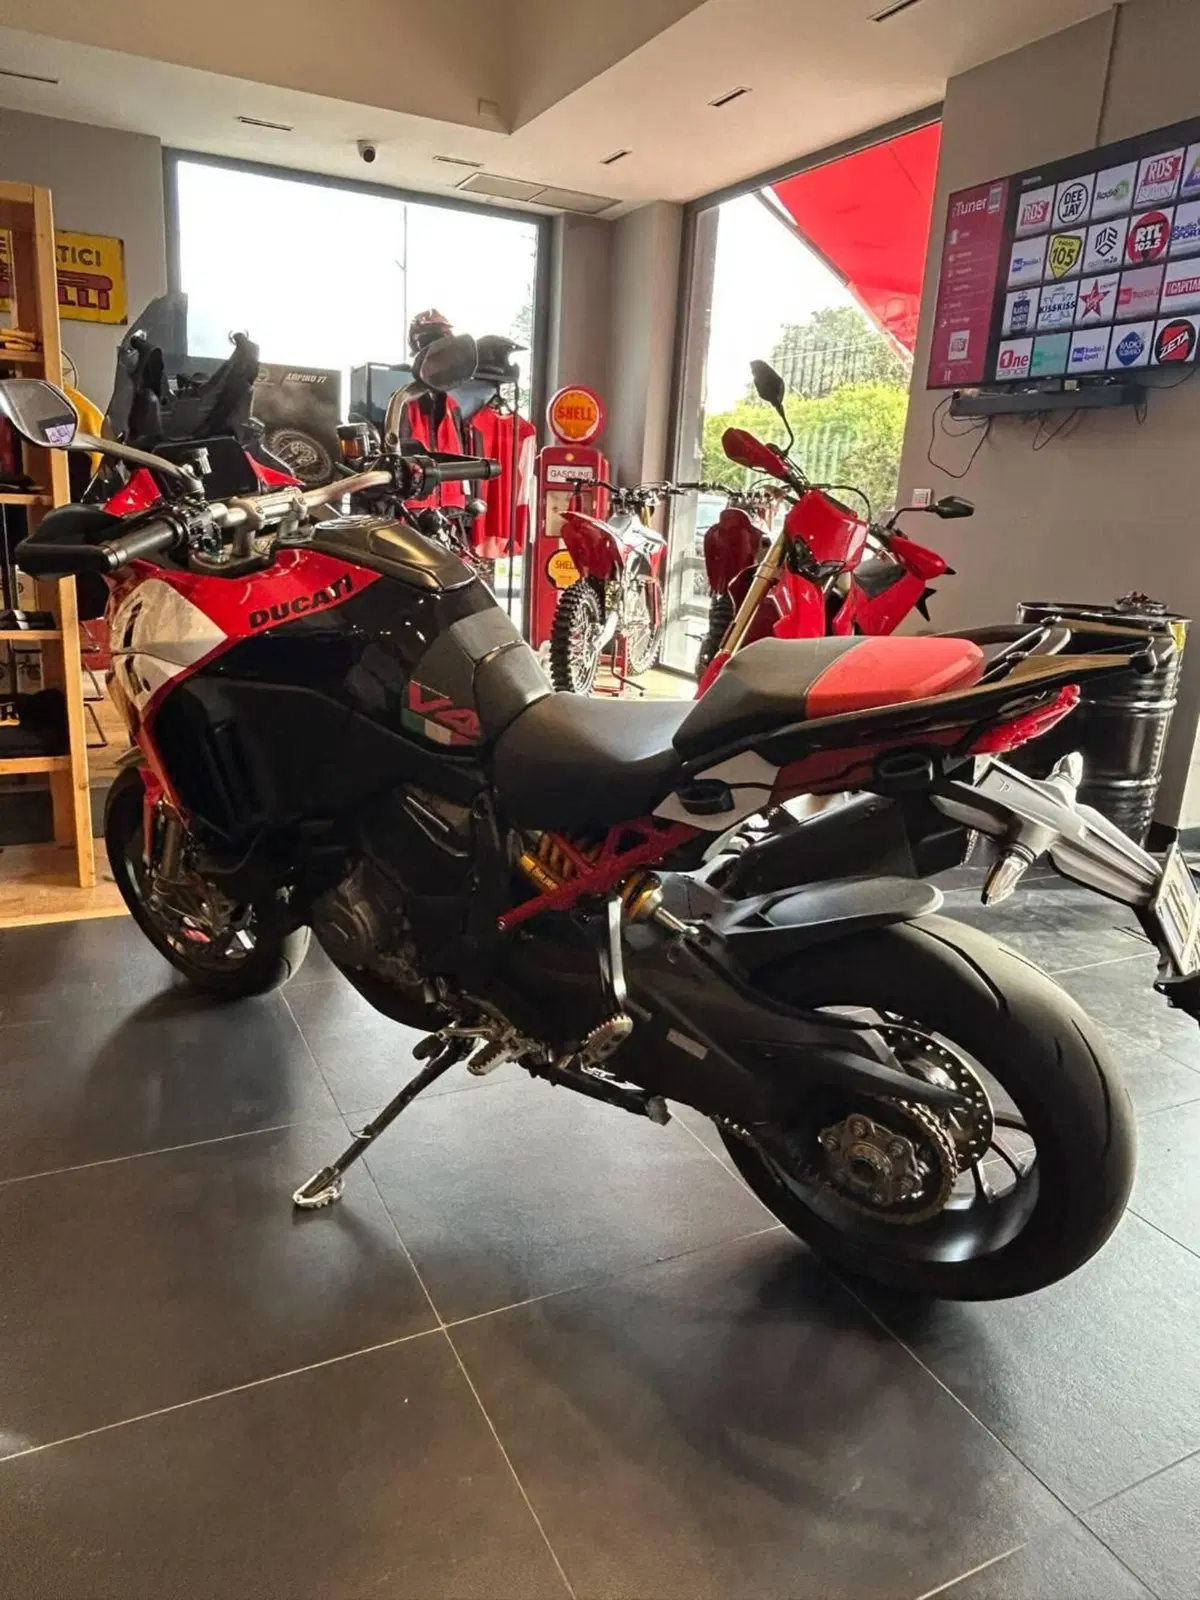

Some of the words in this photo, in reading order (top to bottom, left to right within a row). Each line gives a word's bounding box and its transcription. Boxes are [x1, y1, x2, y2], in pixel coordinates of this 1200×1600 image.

[1064, 189, 1083, 204] DEE
[1062, 202, 1082, 218] JAY
[1136, 223, 1163, 242] RTL
[1134, 238, 1161, 252] 102.5
[56, 245, 102, 267] TICI
[1052, 247, 1076, 267] 105
[1158, 329, 1190, 359] ZETA
[557, 407, 593, 421] SHELL
[248, 573, 354, 629] DUCATI
